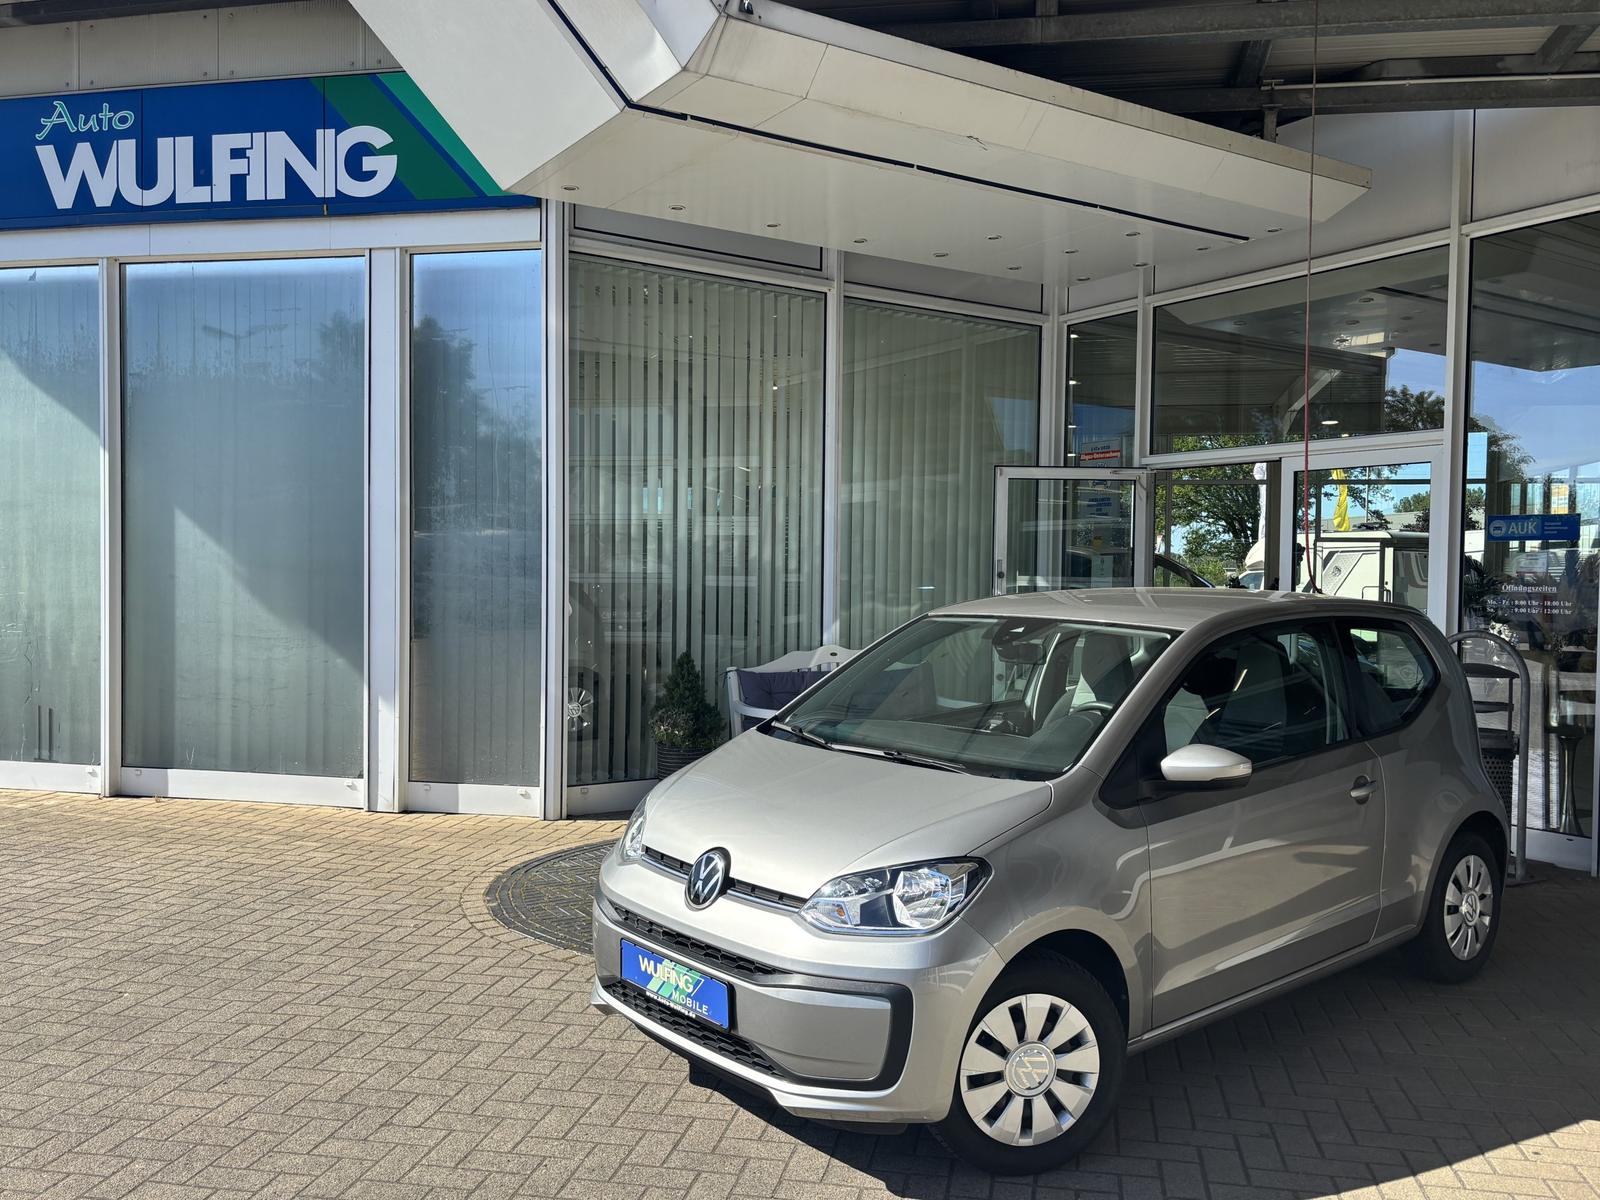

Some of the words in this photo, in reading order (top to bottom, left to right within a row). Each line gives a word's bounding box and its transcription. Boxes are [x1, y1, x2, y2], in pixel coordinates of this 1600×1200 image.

[35, 101, 134, 140] Auto
[35, 125, 398, 210] WULFING
[1508, 521, 1537, 534] AUK
[1502, 583, 1557, 593] Öffnungszeiten
[639, 954, 694, 993] WULFING
[672, 989, 709, 1015] MOBILE
